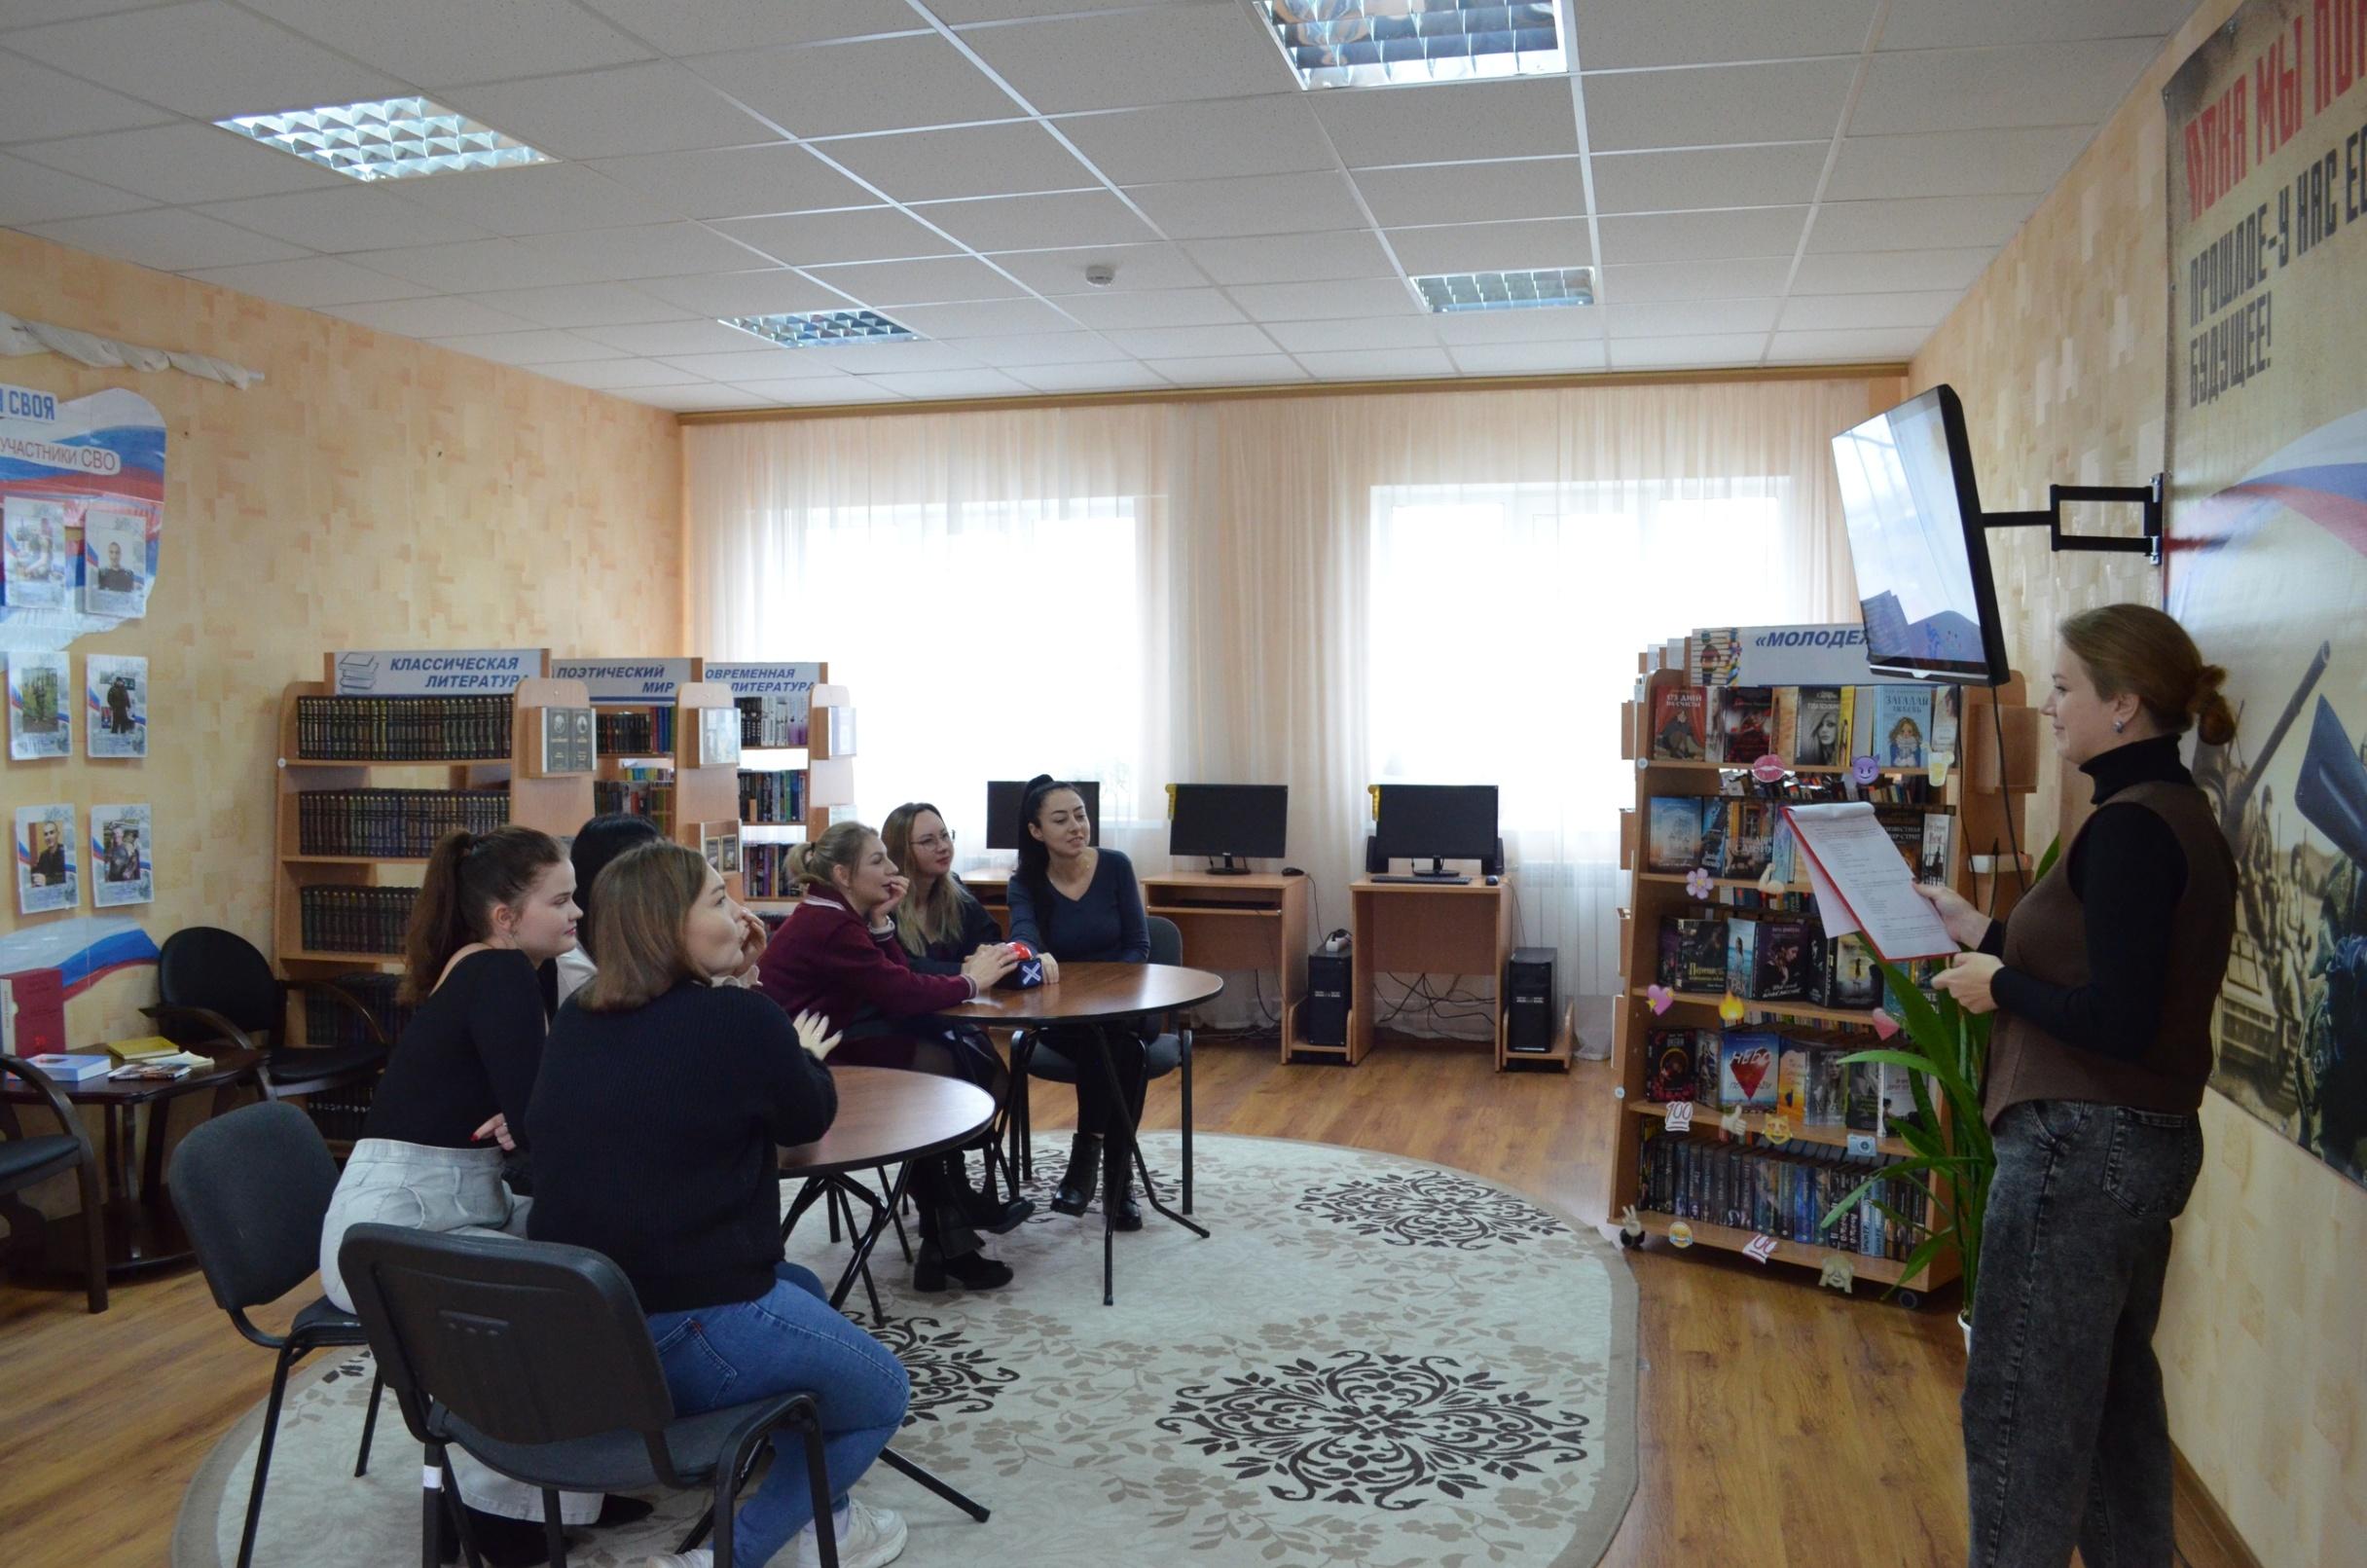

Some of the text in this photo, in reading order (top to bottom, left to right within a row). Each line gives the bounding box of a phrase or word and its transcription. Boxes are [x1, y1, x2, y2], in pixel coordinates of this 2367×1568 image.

[2185, 0, 2367, 223] ПОКА МЫ ПО
[2297, 148, 2337, 257] НАС
[2190, 291, 2272, 409] БУДУЩЕЕ!
[9, 390, 55, 420] СВОЯ
[0, 437, 116, 471] УЧАСТНИКИ СВО
[389, 657, 520, 672] КЛАССИЧЕСКАЯ
[557, 664, 666, 678] ПОЭТИЧЕСКИЙ
[705, 668, 795, 679] ОВРЕМЕННАЯ
[424, 674, 528, 688] ЛИТЕРАТУР
[641, 681, 674, 693] МИР
[1666, 1102, 1693, 1120] 100
